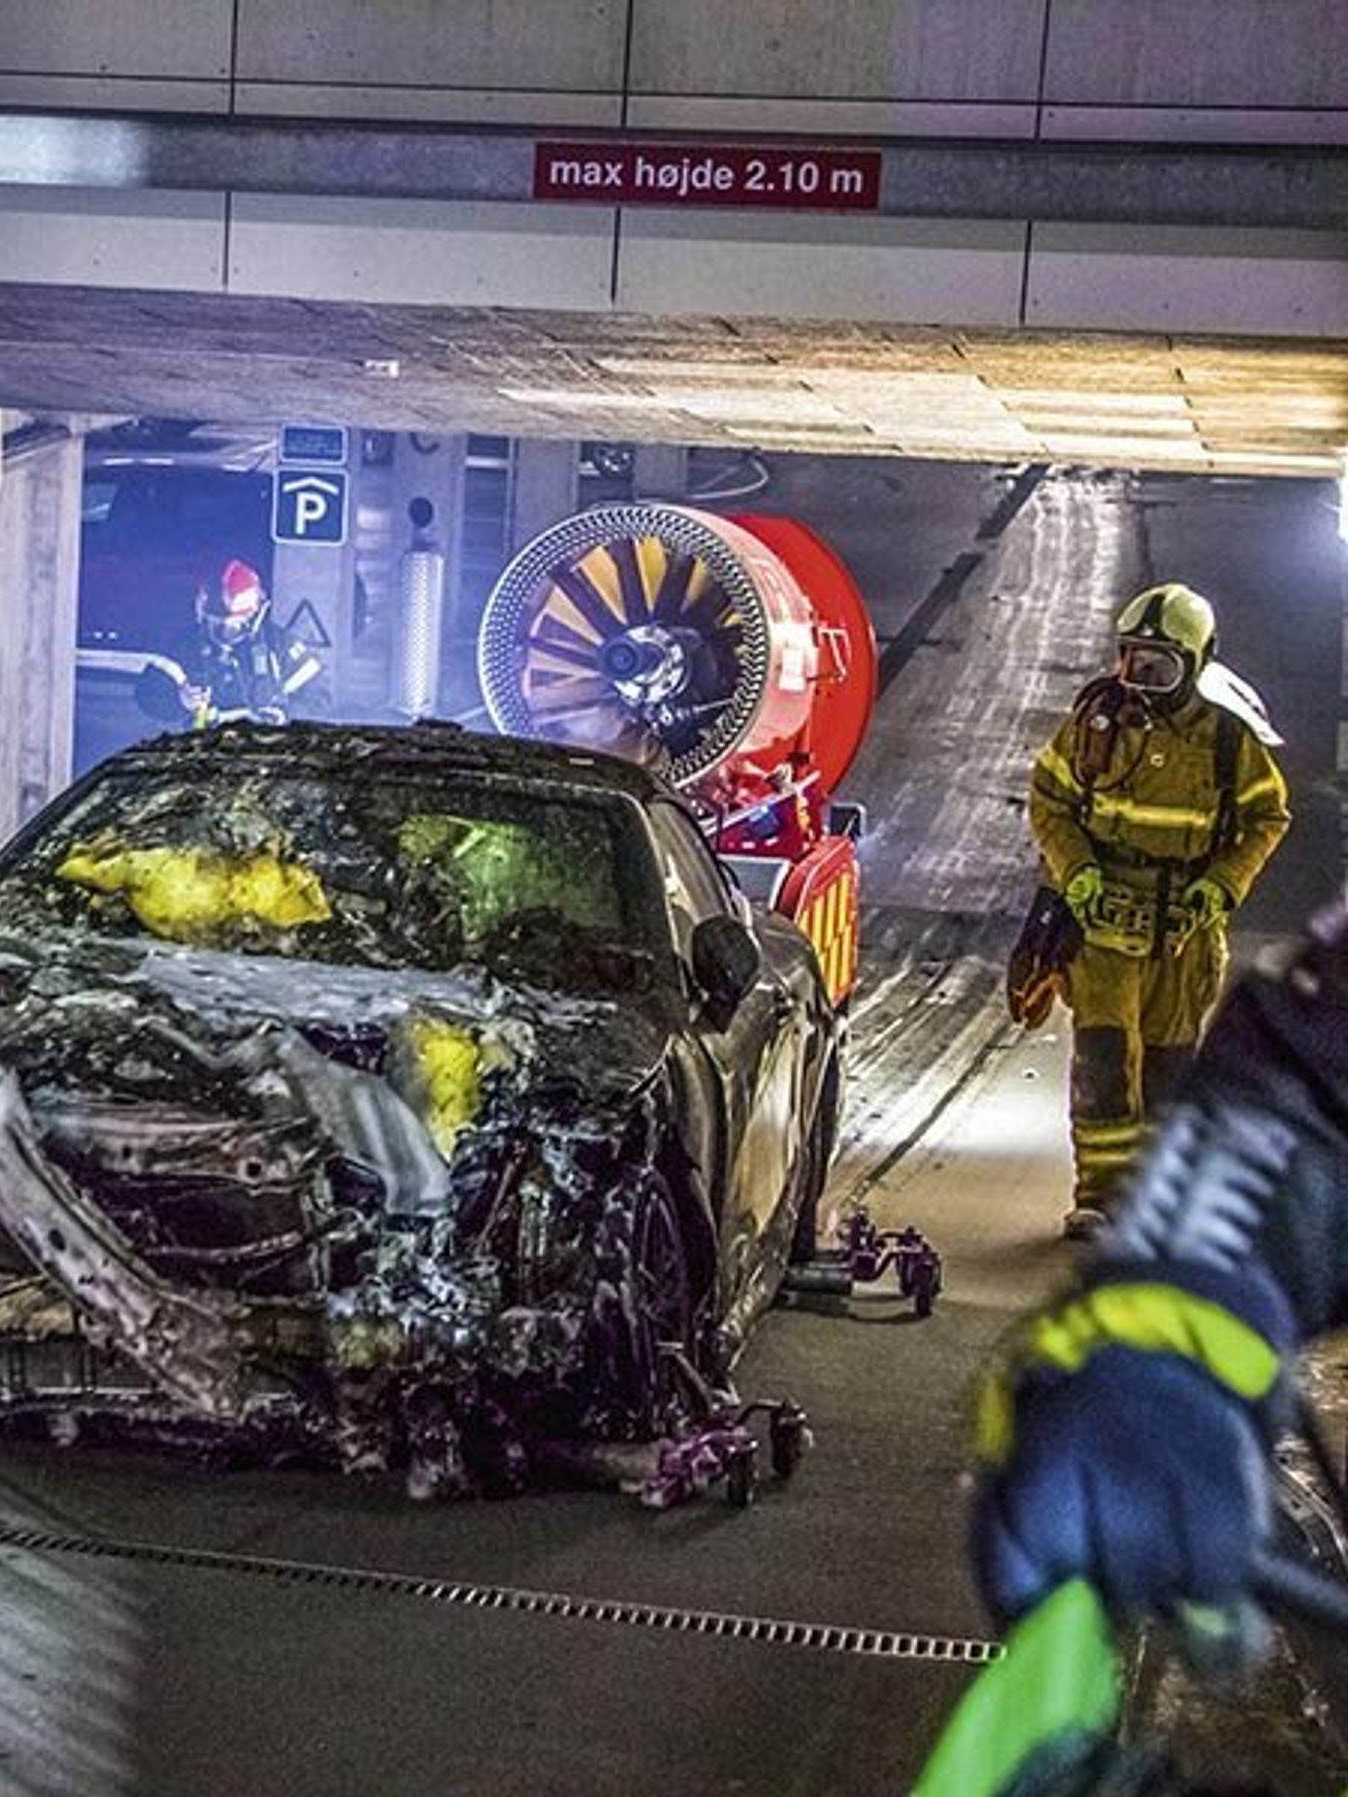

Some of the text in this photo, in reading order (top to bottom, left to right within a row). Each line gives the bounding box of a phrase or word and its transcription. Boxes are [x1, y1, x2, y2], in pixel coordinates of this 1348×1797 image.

[550, 156, 864, 196] max højde 2.10 m
[295, 491, 327, 534] P
